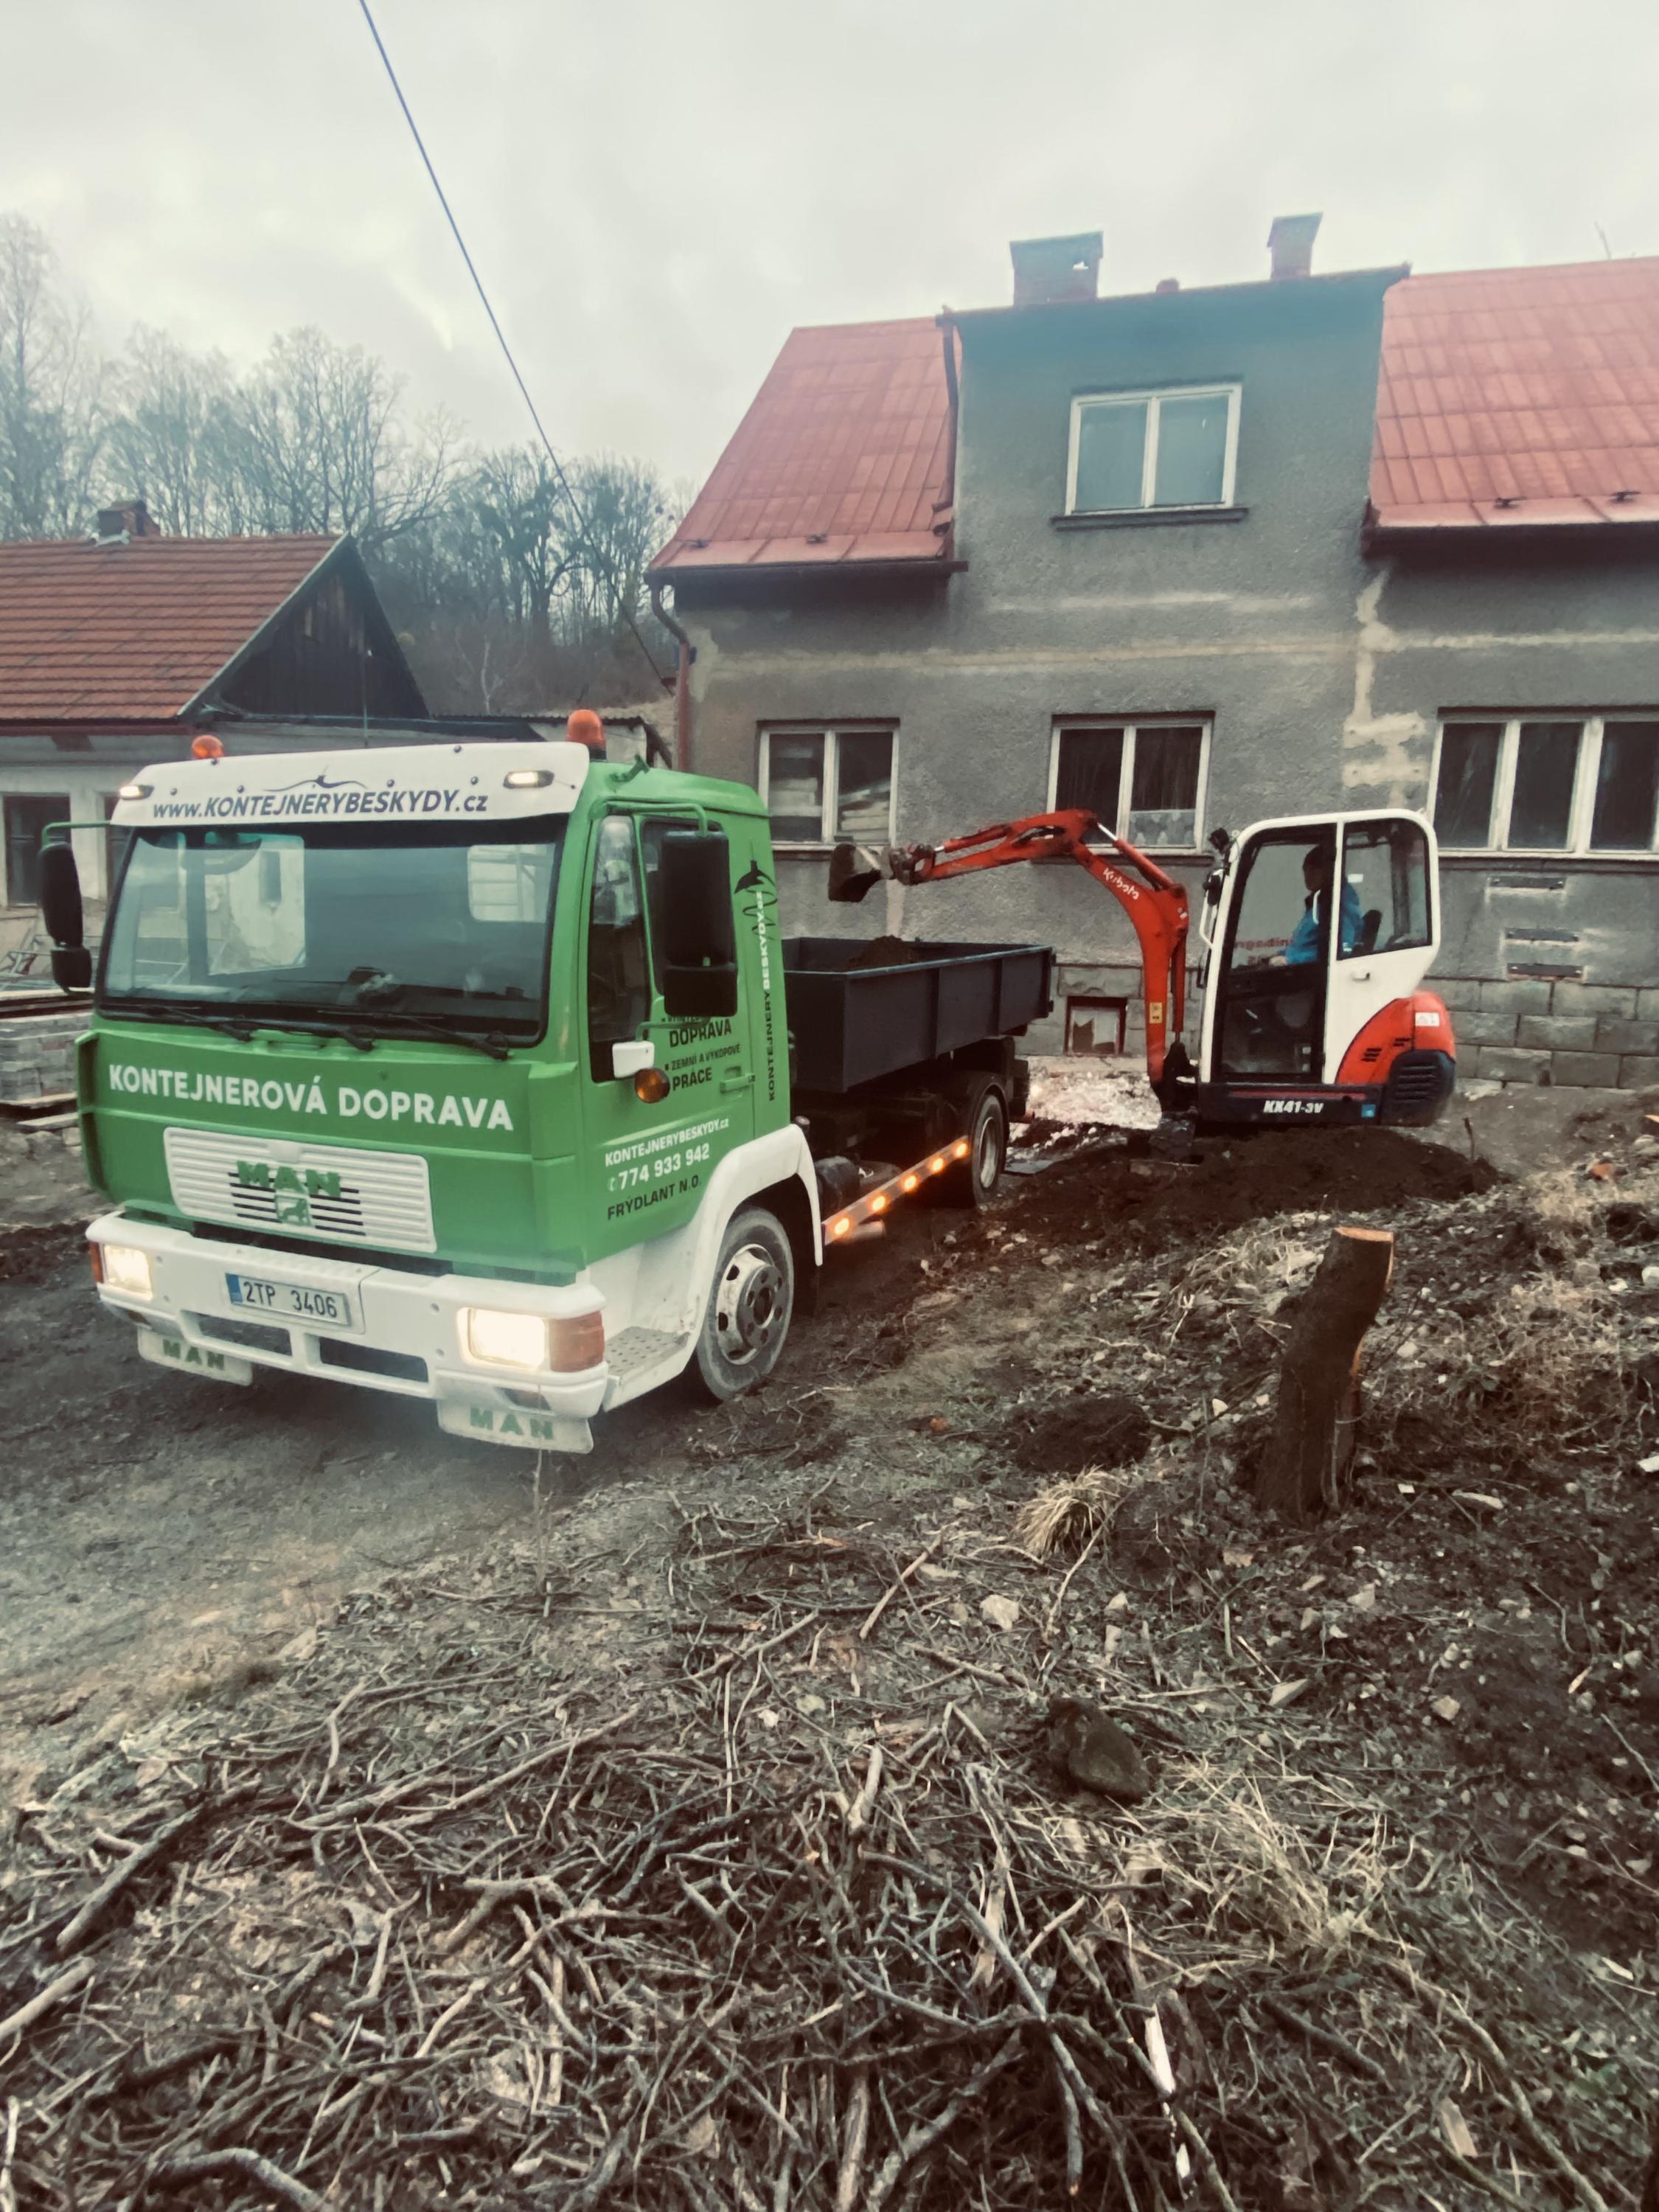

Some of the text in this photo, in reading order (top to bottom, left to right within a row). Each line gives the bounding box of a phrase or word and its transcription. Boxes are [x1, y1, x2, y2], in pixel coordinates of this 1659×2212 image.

[153, 789, 488, 818] www.KONTEJNERYBESKYDY.cz
[1103, 867, 1139, 900] Kubota
[669, 1018, 731, 1048] DOPRAVA
[109, 1064, 514, 1131] KONTEJNEROVÁ DOPRAVA
[605, 1118, 729, 1167] KONTEJNERYBESKYDY.cz
[236, 1160, 342, 1198] MAN
[618, 1142, 710, 1191] 774 933 942
[243, 1281, 337, 1318] 2TP 3406
[162, 1331, 225, 1371] MAN
[470, 1407, 554, 1440] MAN
